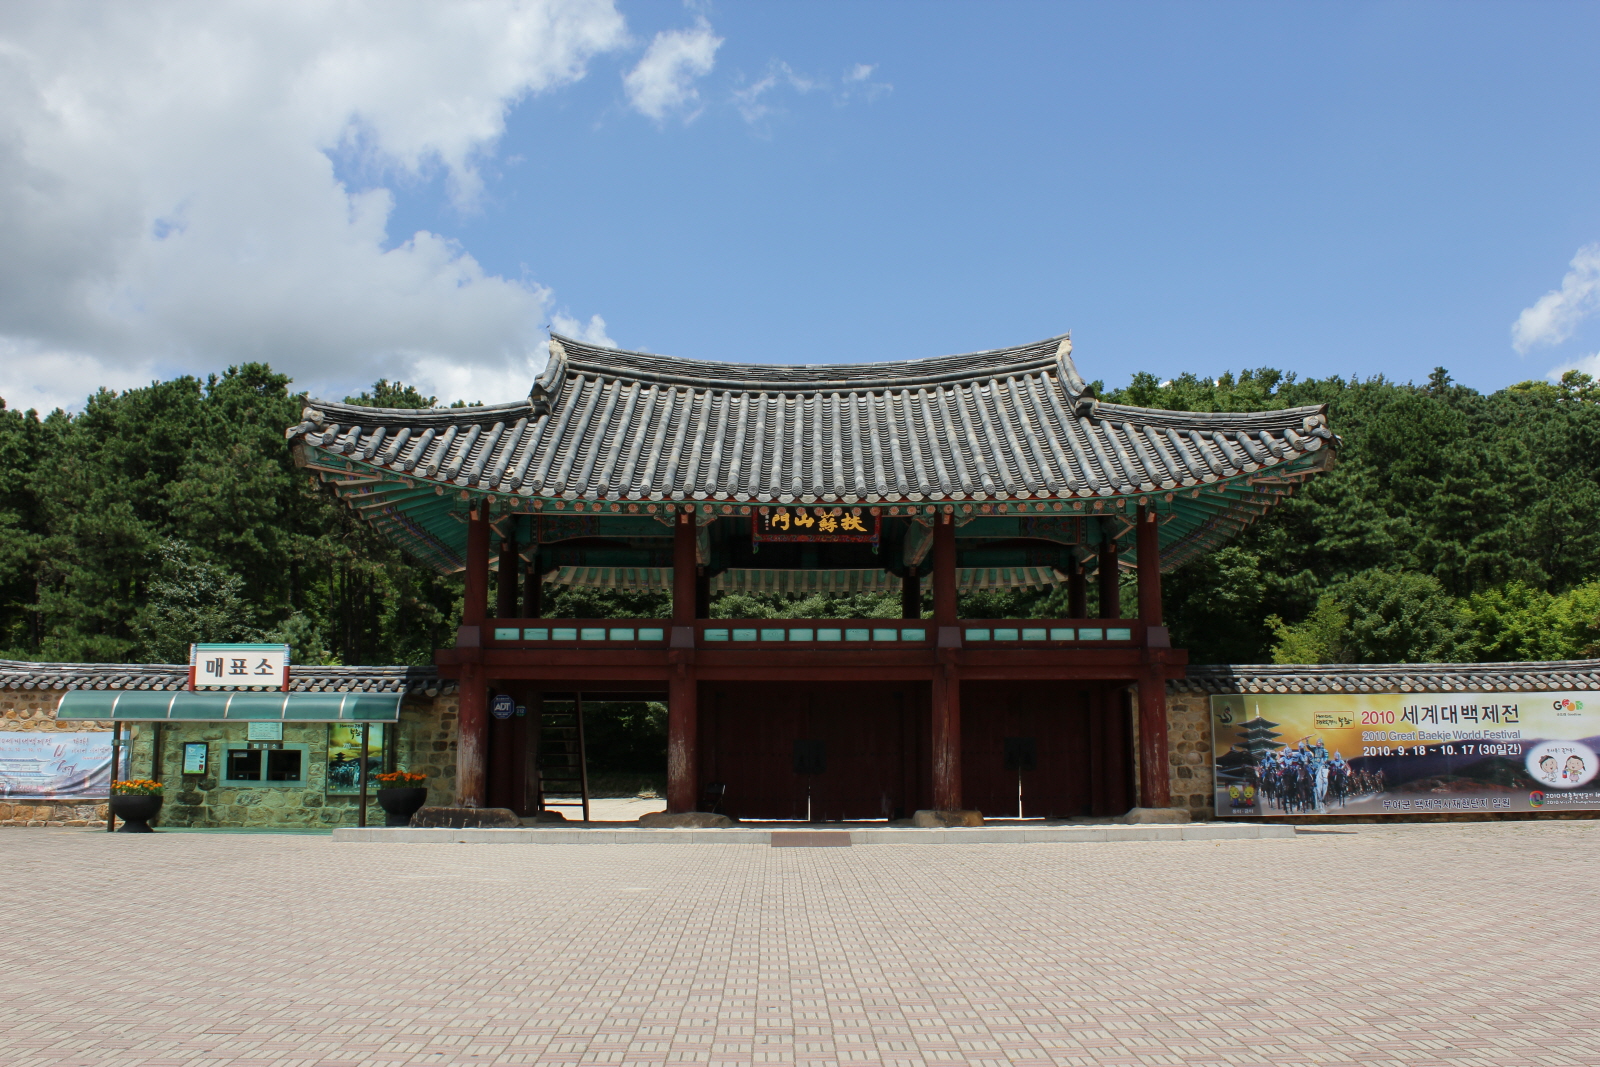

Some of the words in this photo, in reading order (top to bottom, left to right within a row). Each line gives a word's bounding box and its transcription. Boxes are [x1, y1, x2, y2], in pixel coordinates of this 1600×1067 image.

[206, 657, 274, 678] 매표소
[494, 702, 510, 711] ADT
[1361, 711, 1395, 725] 2010
[1400, 704, 1520, 725] 세계대백제전
[0, 737, 52, 746] 0세계대백제전
[1362, 731, 1387, 741] 2010
[1388, 730, 1416, 741] Great
[1418, 730, 1451, 742] Baekje
[1452, 730, 1483, 740] World
[1483, 729, 1521, 740] Festival
[1363, 746, 1394, 757] 2010.
[1397, 746, 1408, 756] 9.
[1413, 745, 1426, 756] 18
[1440, 745, 1458, 755] 10.
[1462, 744, 1475, 755] 17
[1478, 743, 1522, 756] (30일간)
[1383, 799, 1411, 810] 부여군
[1415, 798, 1488, 810] 백제역사재현단지
[1492, 798, 1511, 809] 일원
